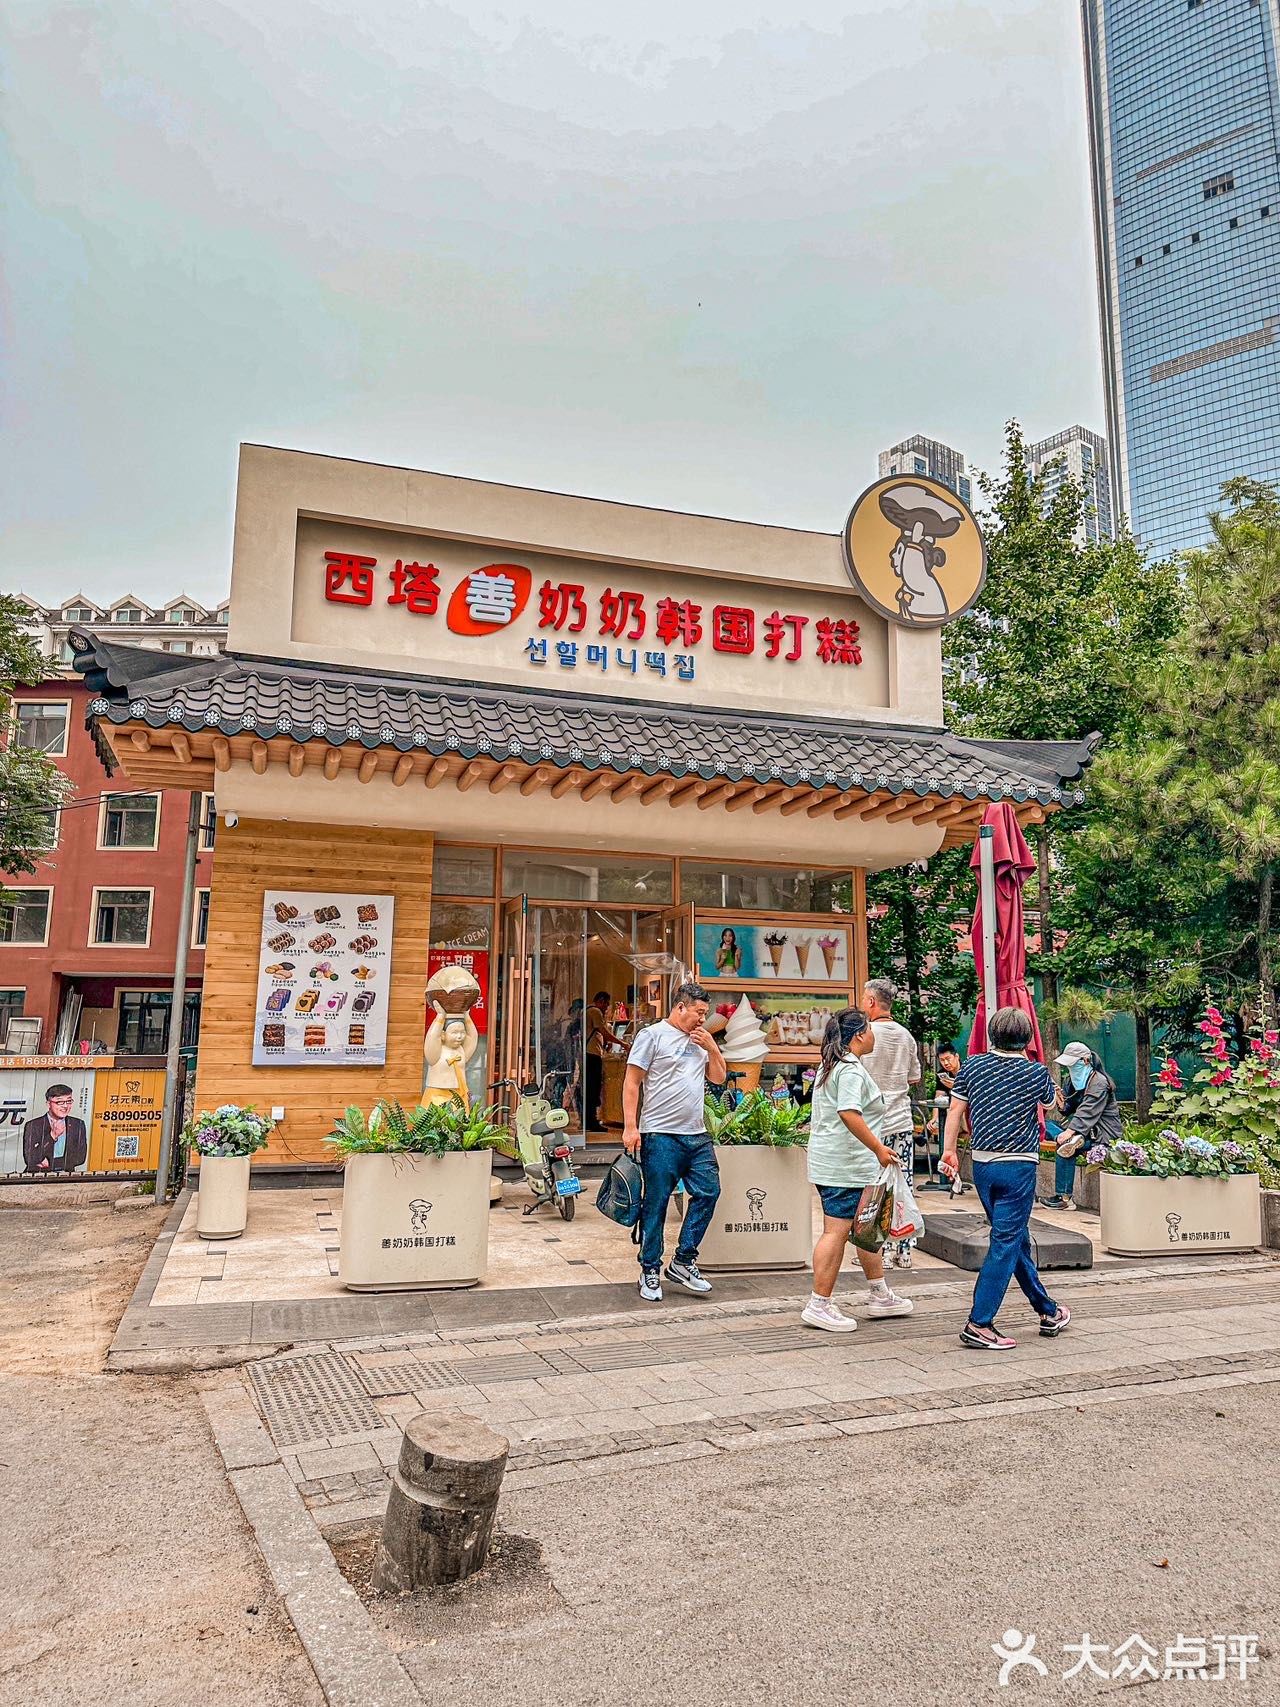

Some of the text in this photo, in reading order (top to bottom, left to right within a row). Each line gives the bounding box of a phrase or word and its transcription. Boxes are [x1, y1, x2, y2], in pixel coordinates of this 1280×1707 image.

[324, 550, 863, 666] 西塔善奶奶韩国打糕
[447, 926, 489, 950] ICE CREAM
[103, 1110, 162, 1121] 88090505
[724, 1222, 789, 1233] 善奶奶韩国打糕
[381, 1236, 457, 1249] 善奶奶韩国打糕
[1181, 1231, 1231, 1242] 善奶奶韩国打糕
